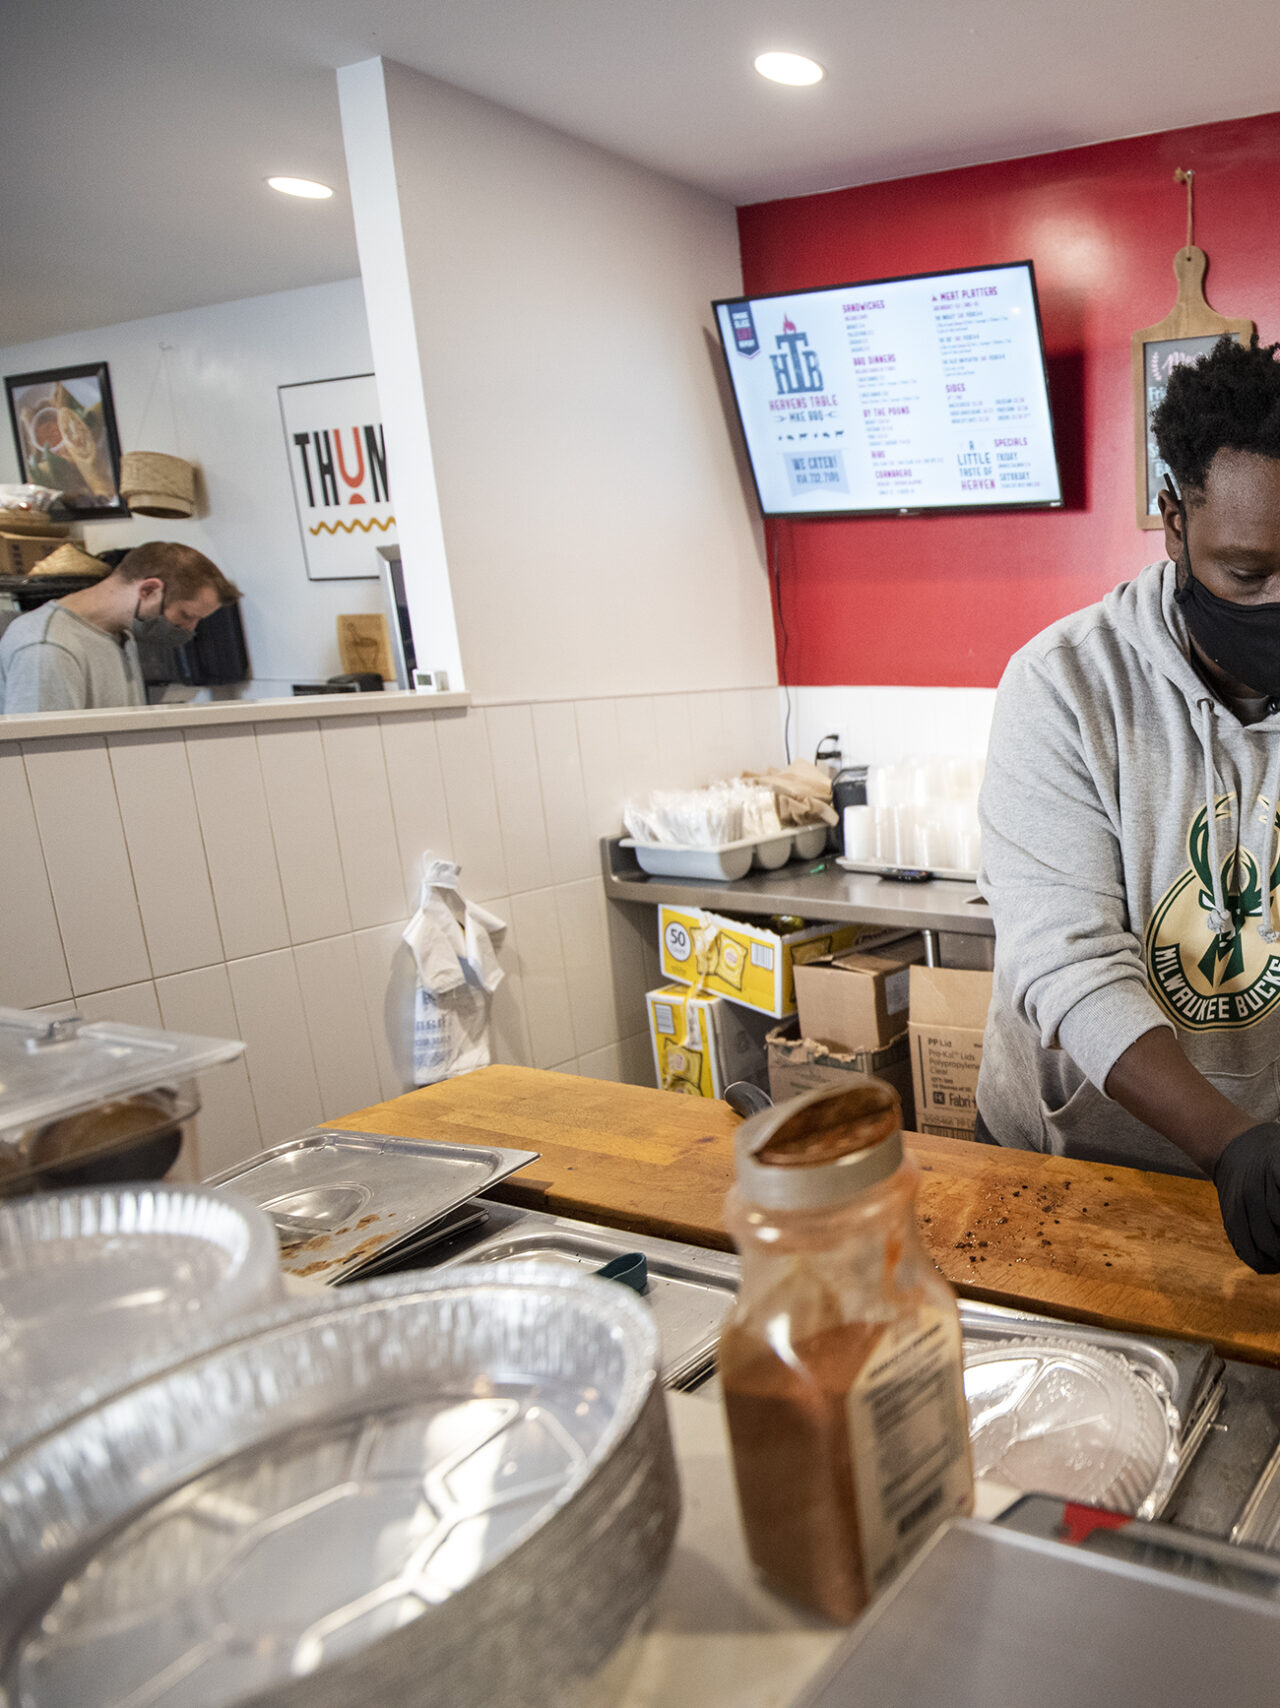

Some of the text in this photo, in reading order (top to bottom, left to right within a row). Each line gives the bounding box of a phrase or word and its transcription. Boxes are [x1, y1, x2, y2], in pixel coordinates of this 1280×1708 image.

[962, 286, 998, 298] PLATTERS
[842, 300, 885, 313] SANDWICHES
[868, 354, 896, 364] DINNERS
[945, 383, 966, 393] SIDES
[810, 394, 838, 408] TABLE
[994, 437, 1028, 447] SPECIALS
[957, 452, 991, 466] LITTLE
[959, 467, 981, 477] TASTE
[961, 479, 996, 490] HEAVEN
[670, 929, 686, 947] 50
[1155, 947, 1229, 1021] MILWAUKEE
[940, 1039, 952, 1048] Lid
